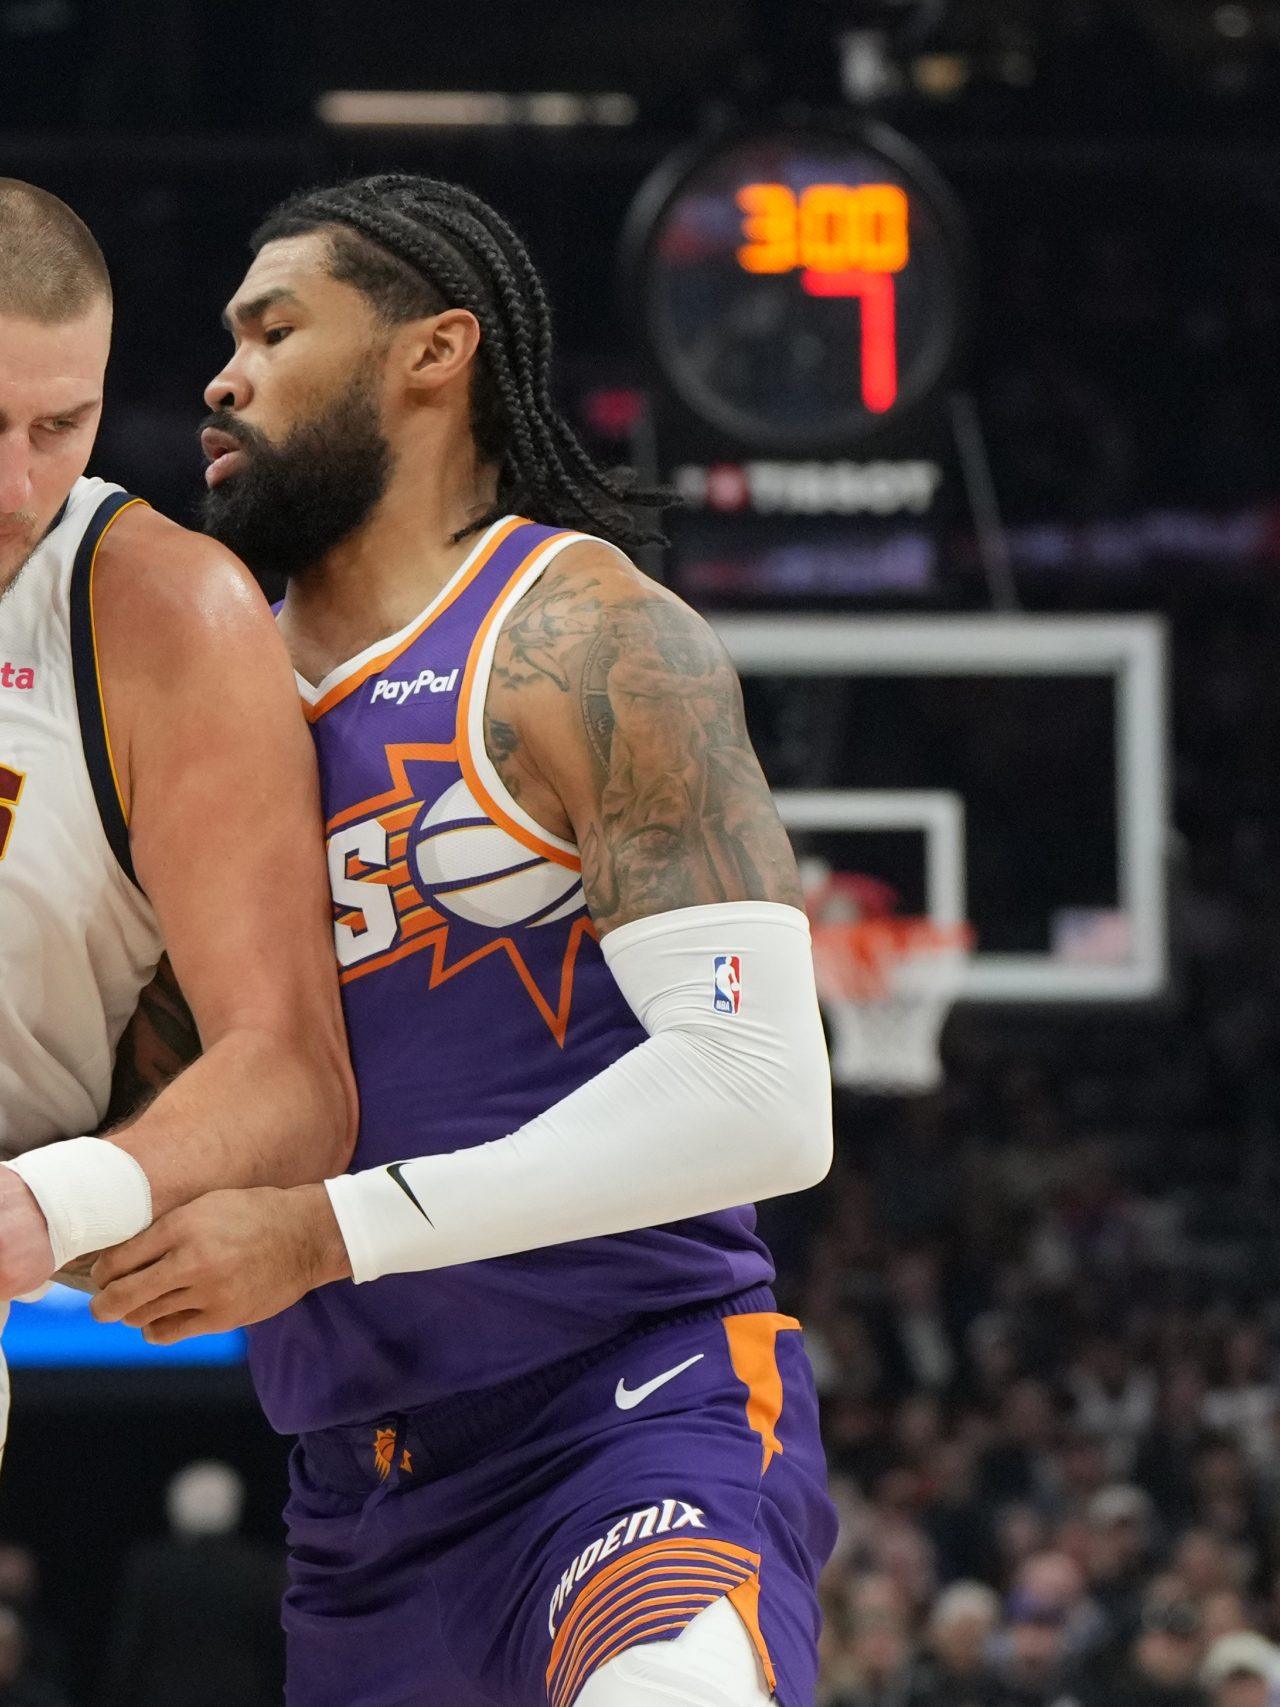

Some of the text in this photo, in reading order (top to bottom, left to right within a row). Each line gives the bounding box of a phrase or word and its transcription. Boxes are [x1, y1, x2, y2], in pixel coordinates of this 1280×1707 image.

[802, 271, 898, 415] 7
[369, 668, 460, 705] PayPal
[548, 1498, 708, 1640] PHOENIX
